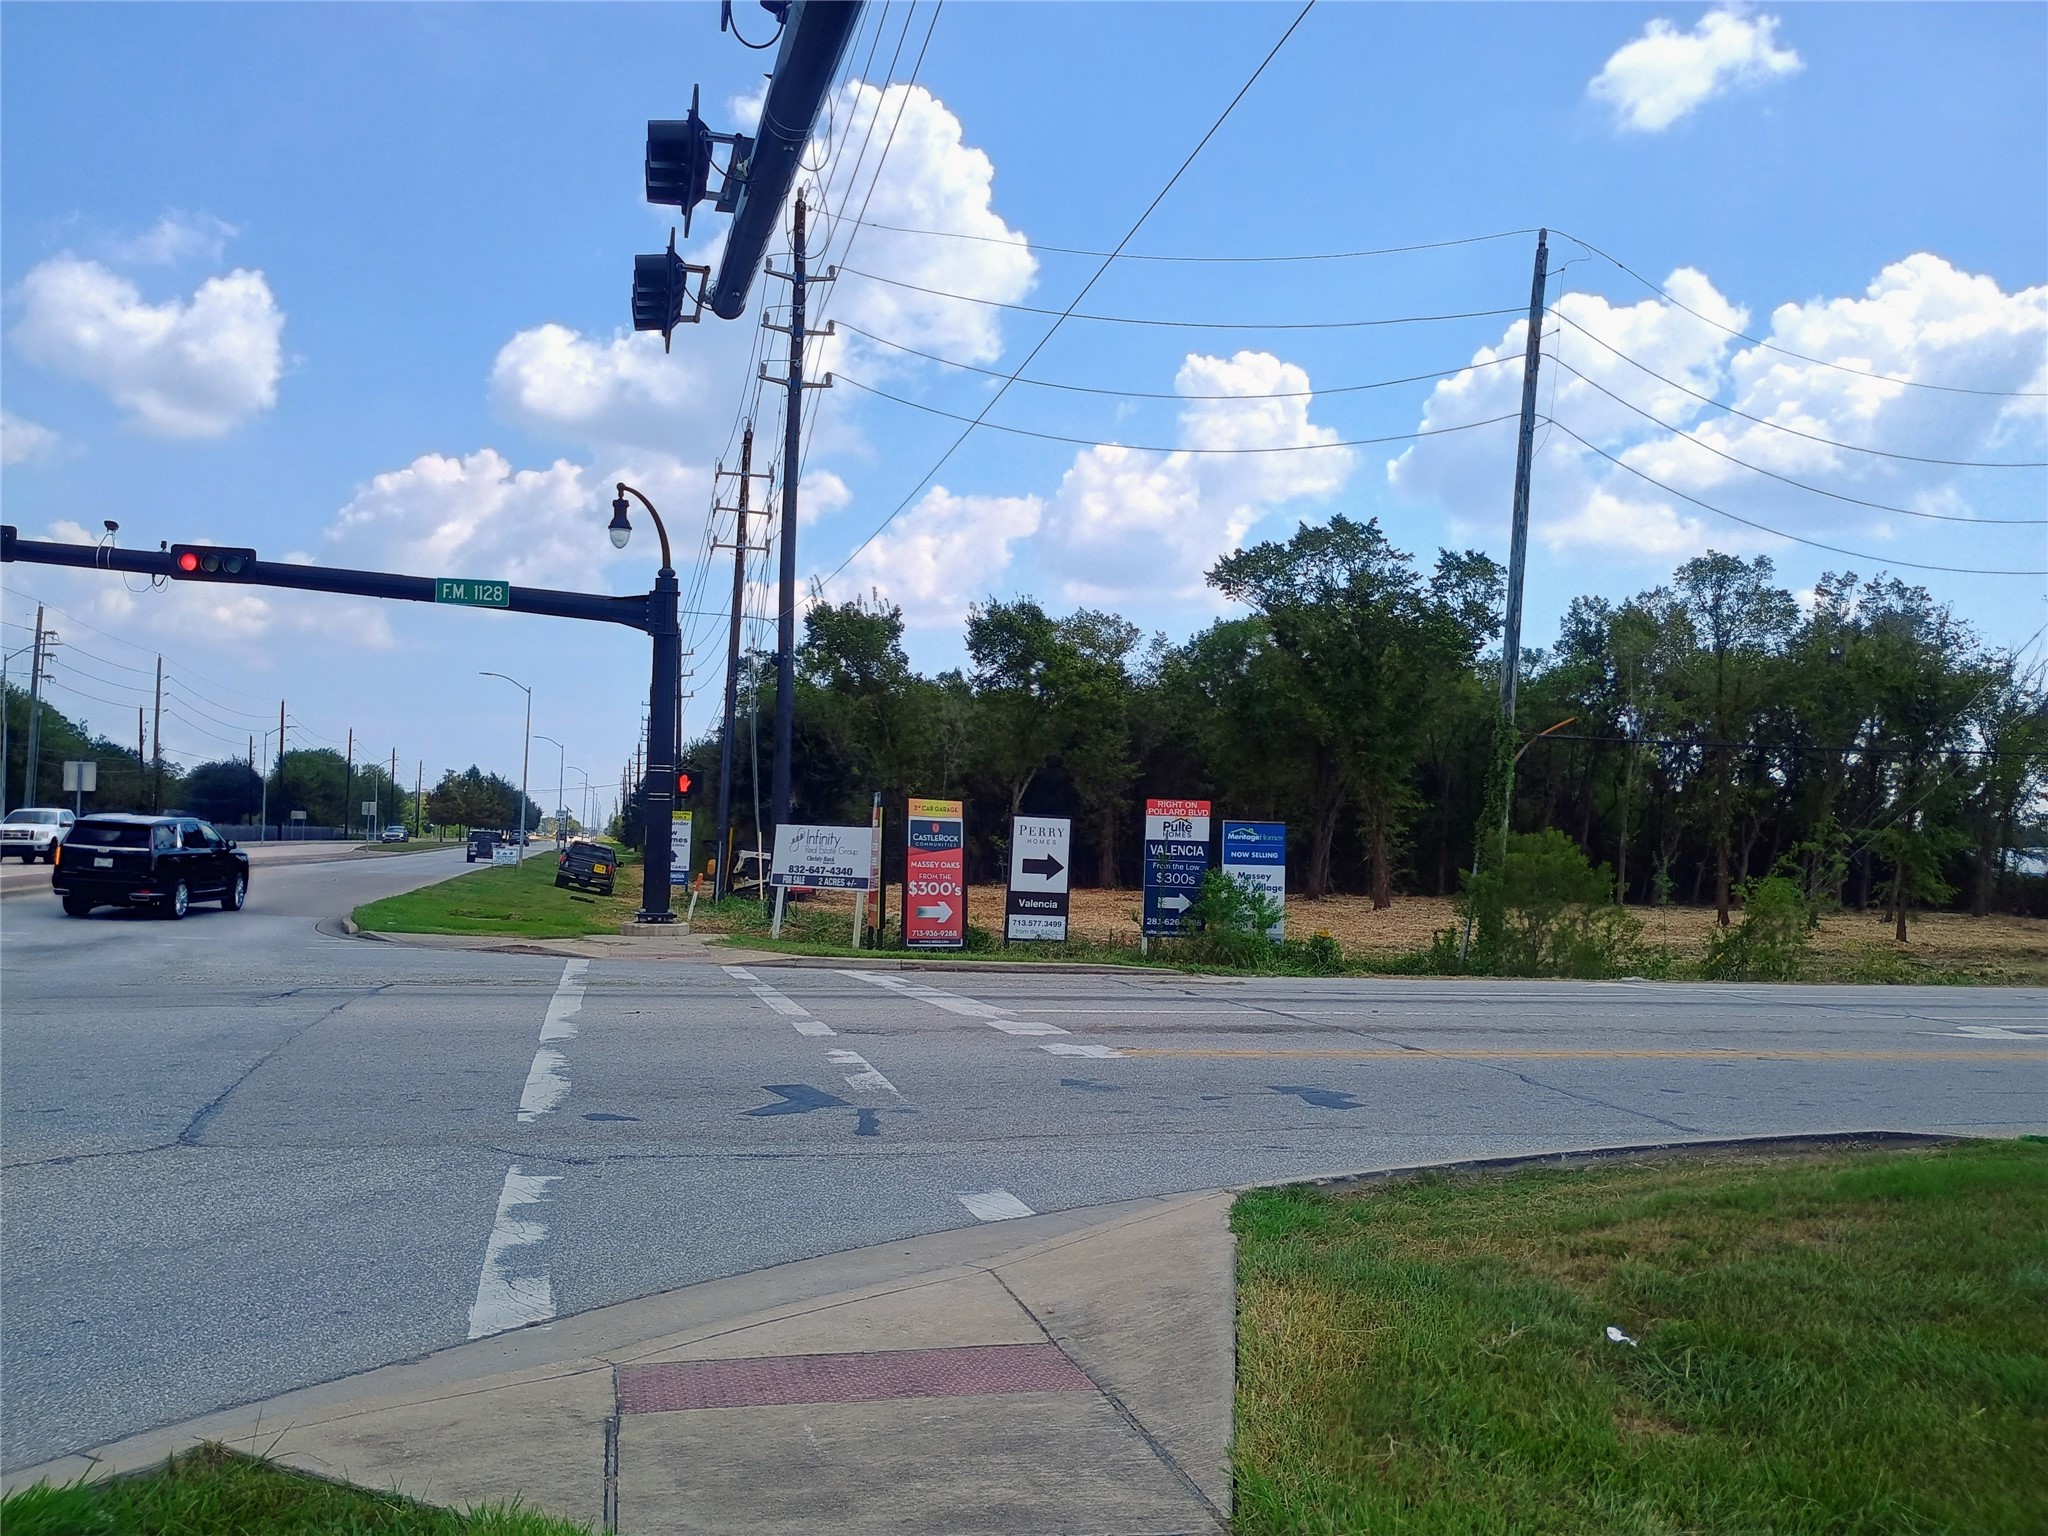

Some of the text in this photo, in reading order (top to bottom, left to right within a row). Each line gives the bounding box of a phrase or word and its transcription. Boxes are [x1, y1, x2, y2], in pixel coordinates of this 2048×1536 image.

[443, 583, 502, 601] F.M. 1128
[1184, 801, 1198, 809] ON
[1148, 808, 1186, 816] POLLARD
[1019, 824, 1065, 838] PERRY
[1163, 820, 1193, 832] Pulte
[806, 828, 841, 848] Infinity
[805, 845, 859, 856] Real Estate Group
[1150, 844, 1204, 857] VALENCIA
[1251, 851, 1279, 859] SELLING
[788, 865, 853, 876] 832-647-4340
[940, 861, 960, 869] OAKS
[1185, 863, 1200, 871] Low
[783, 875, 792, 884] FOR
[793, 876, 806, 885] SALE
[823, 878, 845, 887] ACRES
[1156, 872, 1196, 885] $300s
[1237, 871, 1272, 882] Massey
[908, 880, 962, 897] $300's
[1018, 898, 1058, 909] Valencia
[1012, 919, 1062, 928] 713.577.3499
